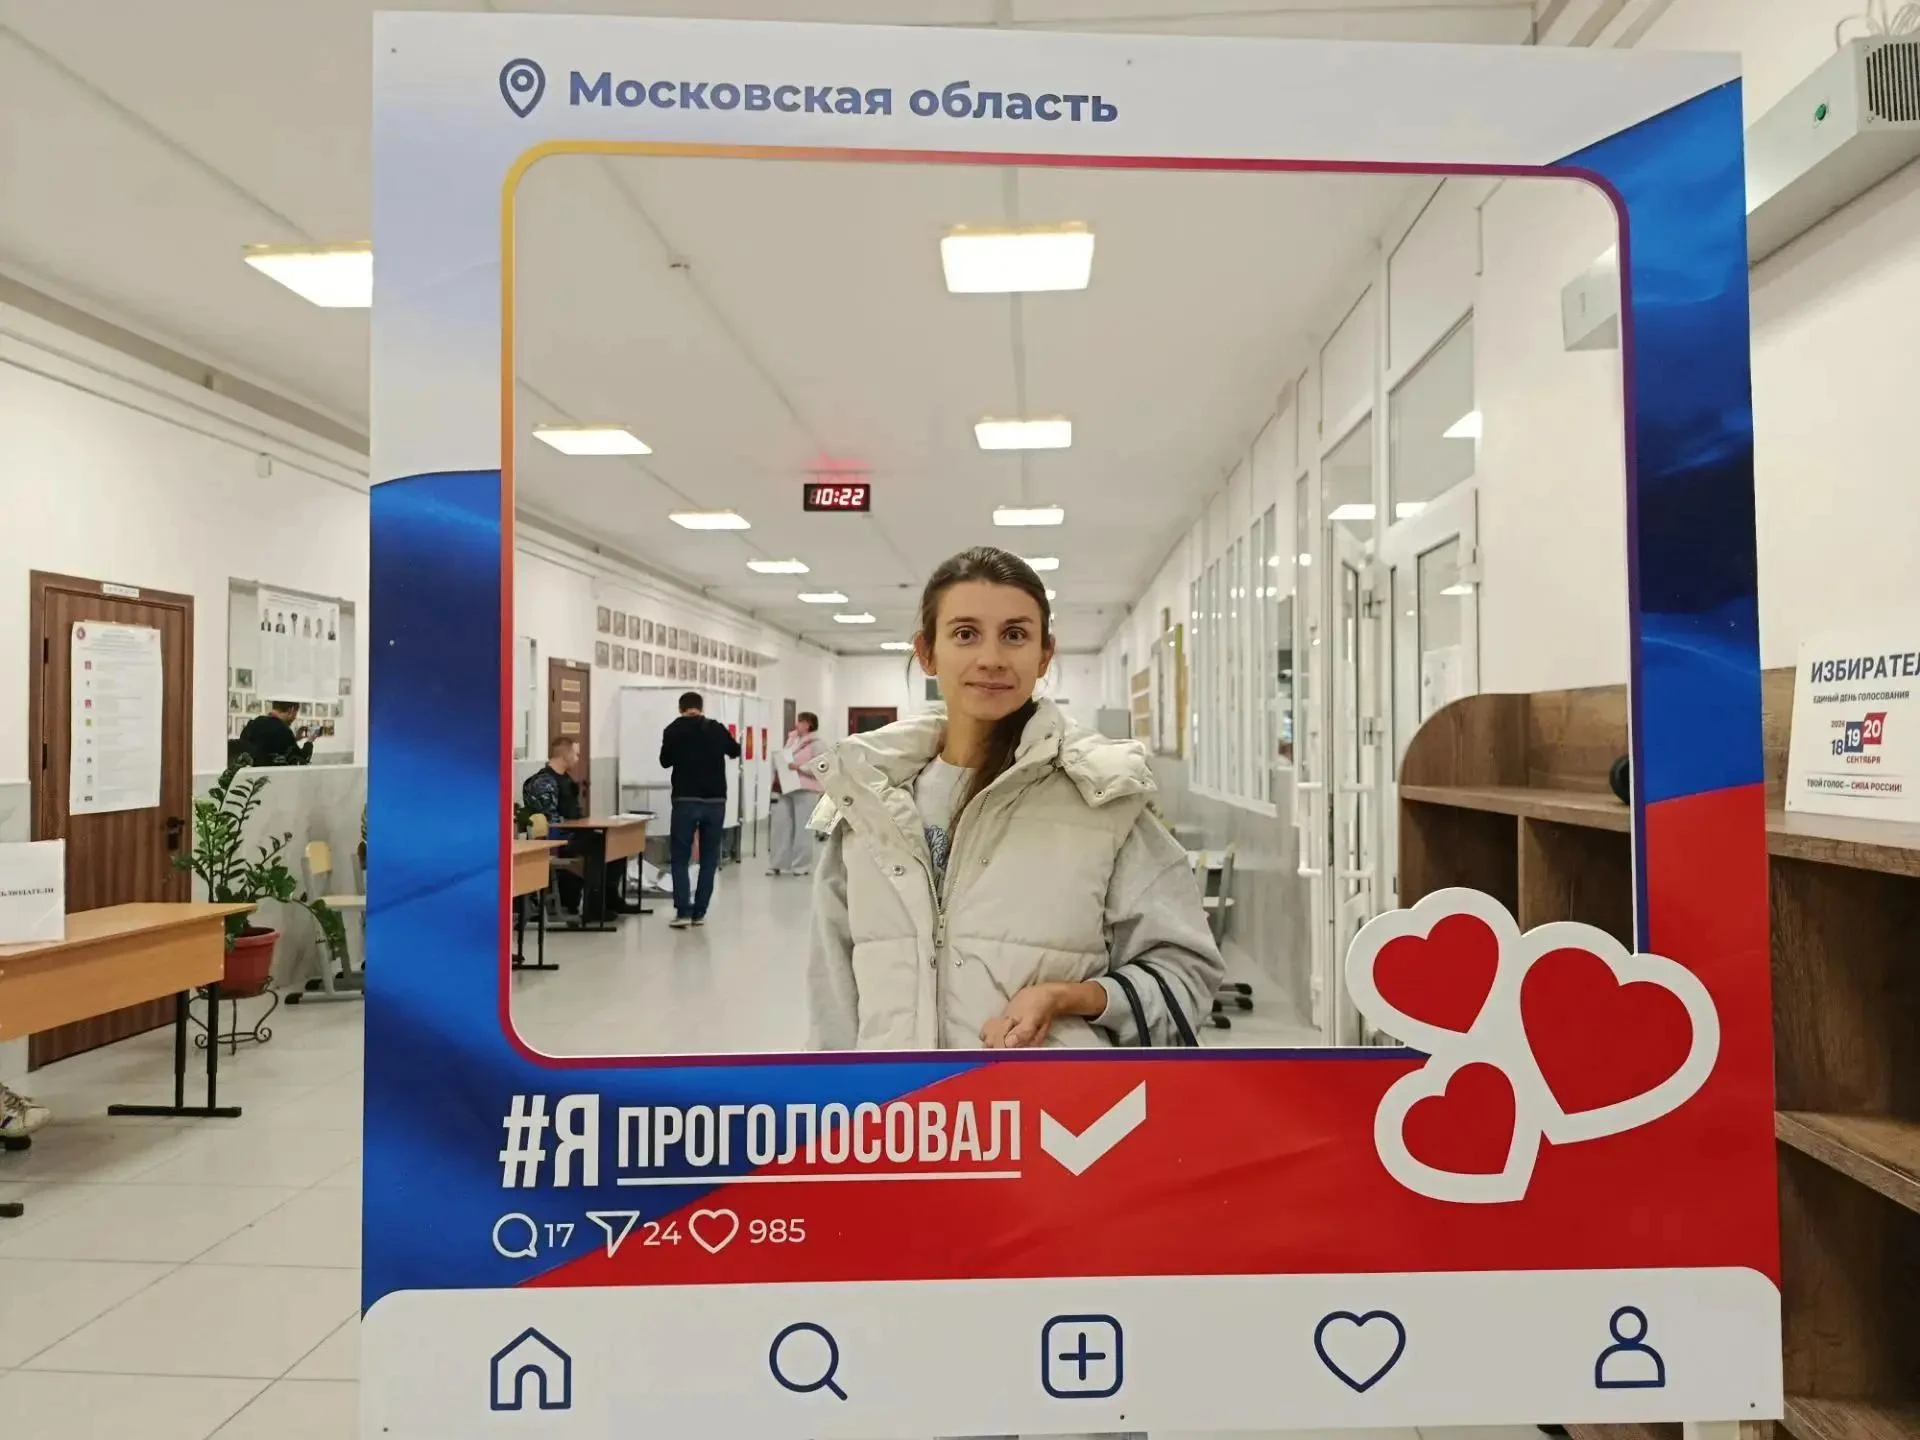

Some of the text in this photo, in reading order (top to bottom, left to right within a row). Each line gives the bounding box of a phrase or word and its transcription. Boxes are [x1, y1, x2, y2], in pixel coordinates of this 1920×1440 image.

[569, 71, 1118, 123] Московская область
[815, 488, 865, 506] 10:22
[1813, 690, 1910, 704] ЕДИНЫЙ ДЕНЬ ГОЛОСОВАНИЯ
[1831, 720, 1882, 756] 18 19 20
[1846, 756, 1881, 764] СЕНТЯБРЯ
[1807, 777, 1823, 788] ТВОЙ
[1824, 780, 1844, 788] ГОЛОС
[1851, 782, 1869, 790] СИЛА
[1870, 783, 1902, 793] РОССИИ!
[499, 1093, 1021, 1188] #Я ПРОГОЛОСОВАЛ
[543, 1223, 575, 1248] 17
[643, 1221, 682, 1246] 24
[749, 1218, 806, 1244] 985
